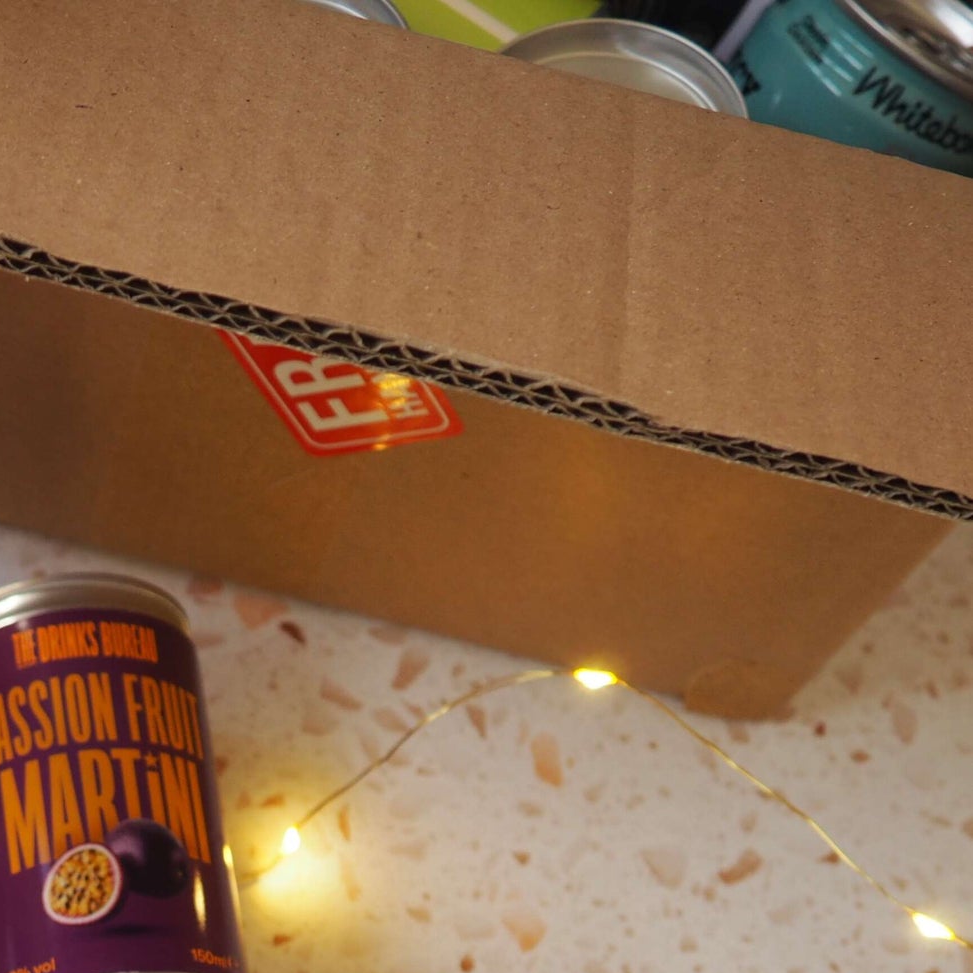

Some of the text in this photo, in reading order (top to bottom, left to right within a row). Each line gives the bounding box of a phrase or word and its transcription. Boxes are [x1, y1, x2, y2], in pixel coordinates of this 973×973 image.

[12, 620, 159, 670] THE DRINKS BUREAU
[123, 673, 204, 760] FRUIT
